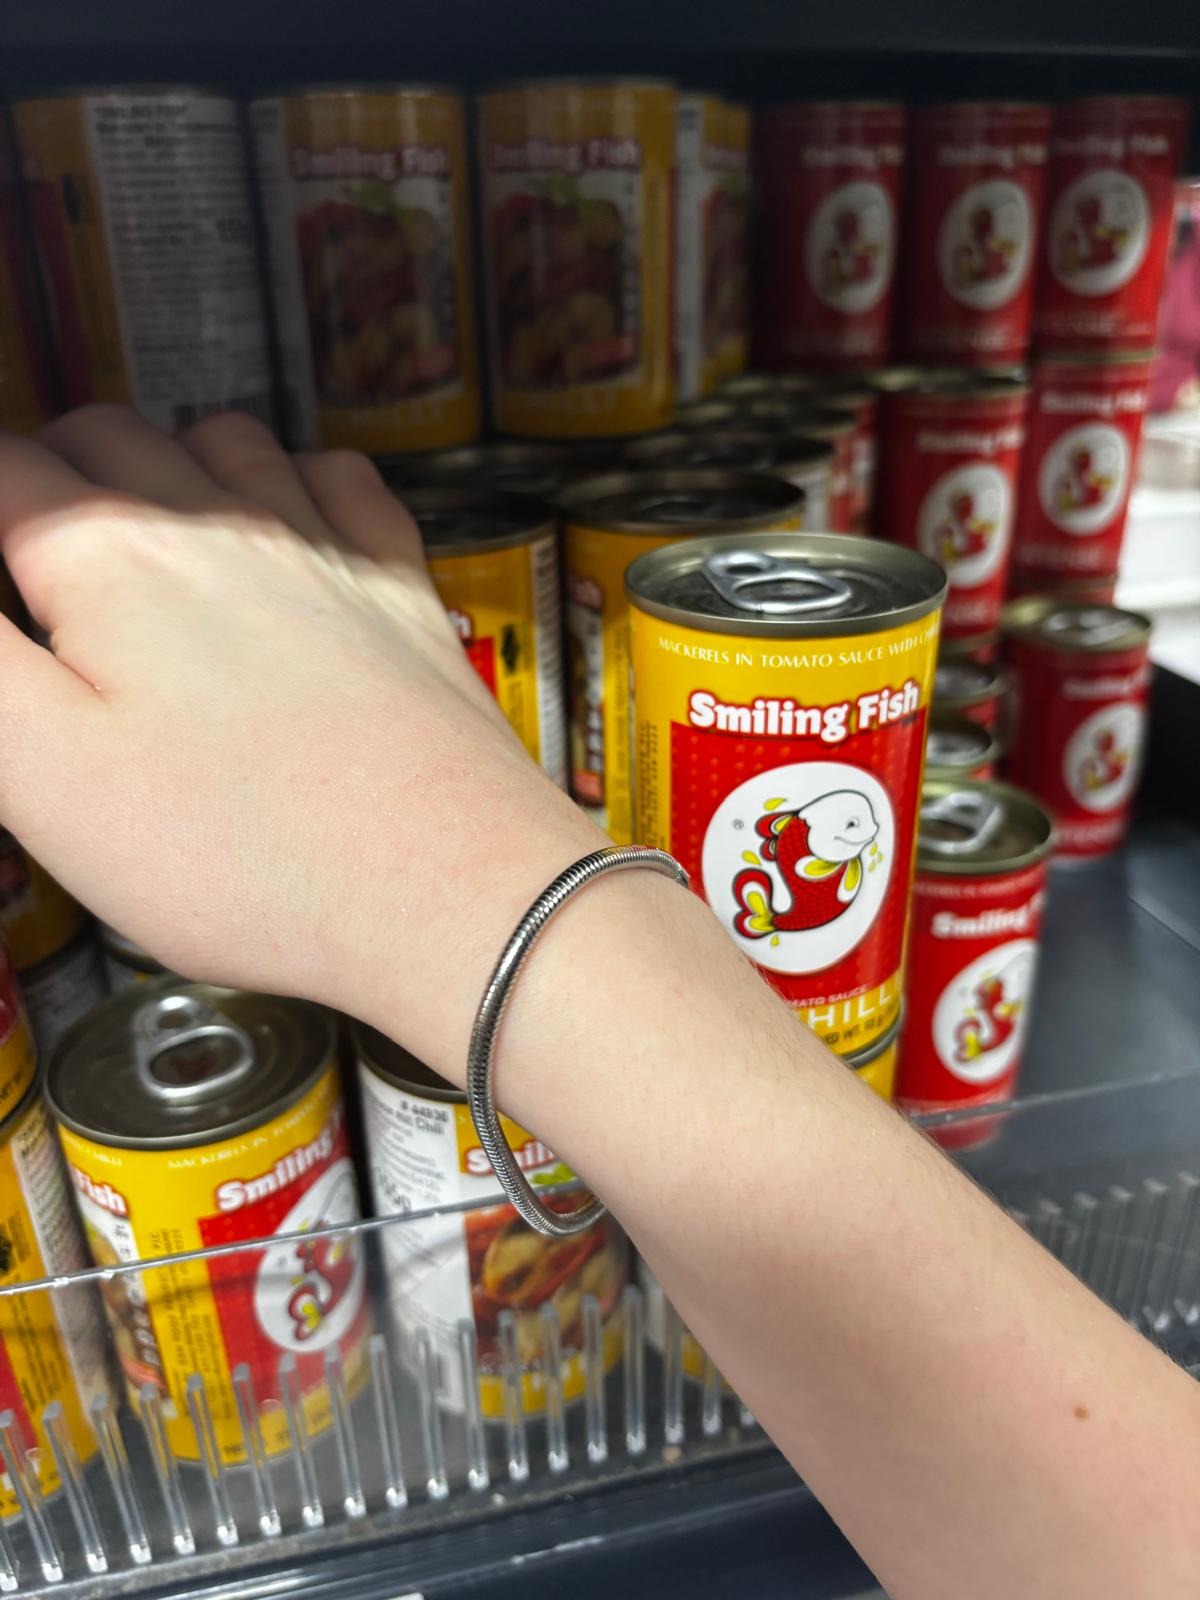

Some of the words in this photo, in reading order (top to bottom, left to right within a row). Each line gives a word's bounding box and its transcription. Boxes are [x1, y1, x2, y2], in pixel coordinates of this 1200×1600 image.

[658, 635, 730, 664] MACKERELS
[735, 653, 753, 666] IN
[760, 654, 833, 668] TOMATO
[838, 645, 883, 665] SAUCE
[888, 635, 917, 656] WITH
[689, 690, 849, 743] Smiling
[857, 679, 919, 730] Fish
[71, 1164, 127, 1213] Fish
[216, 1128, 334, 1212] Smiling
